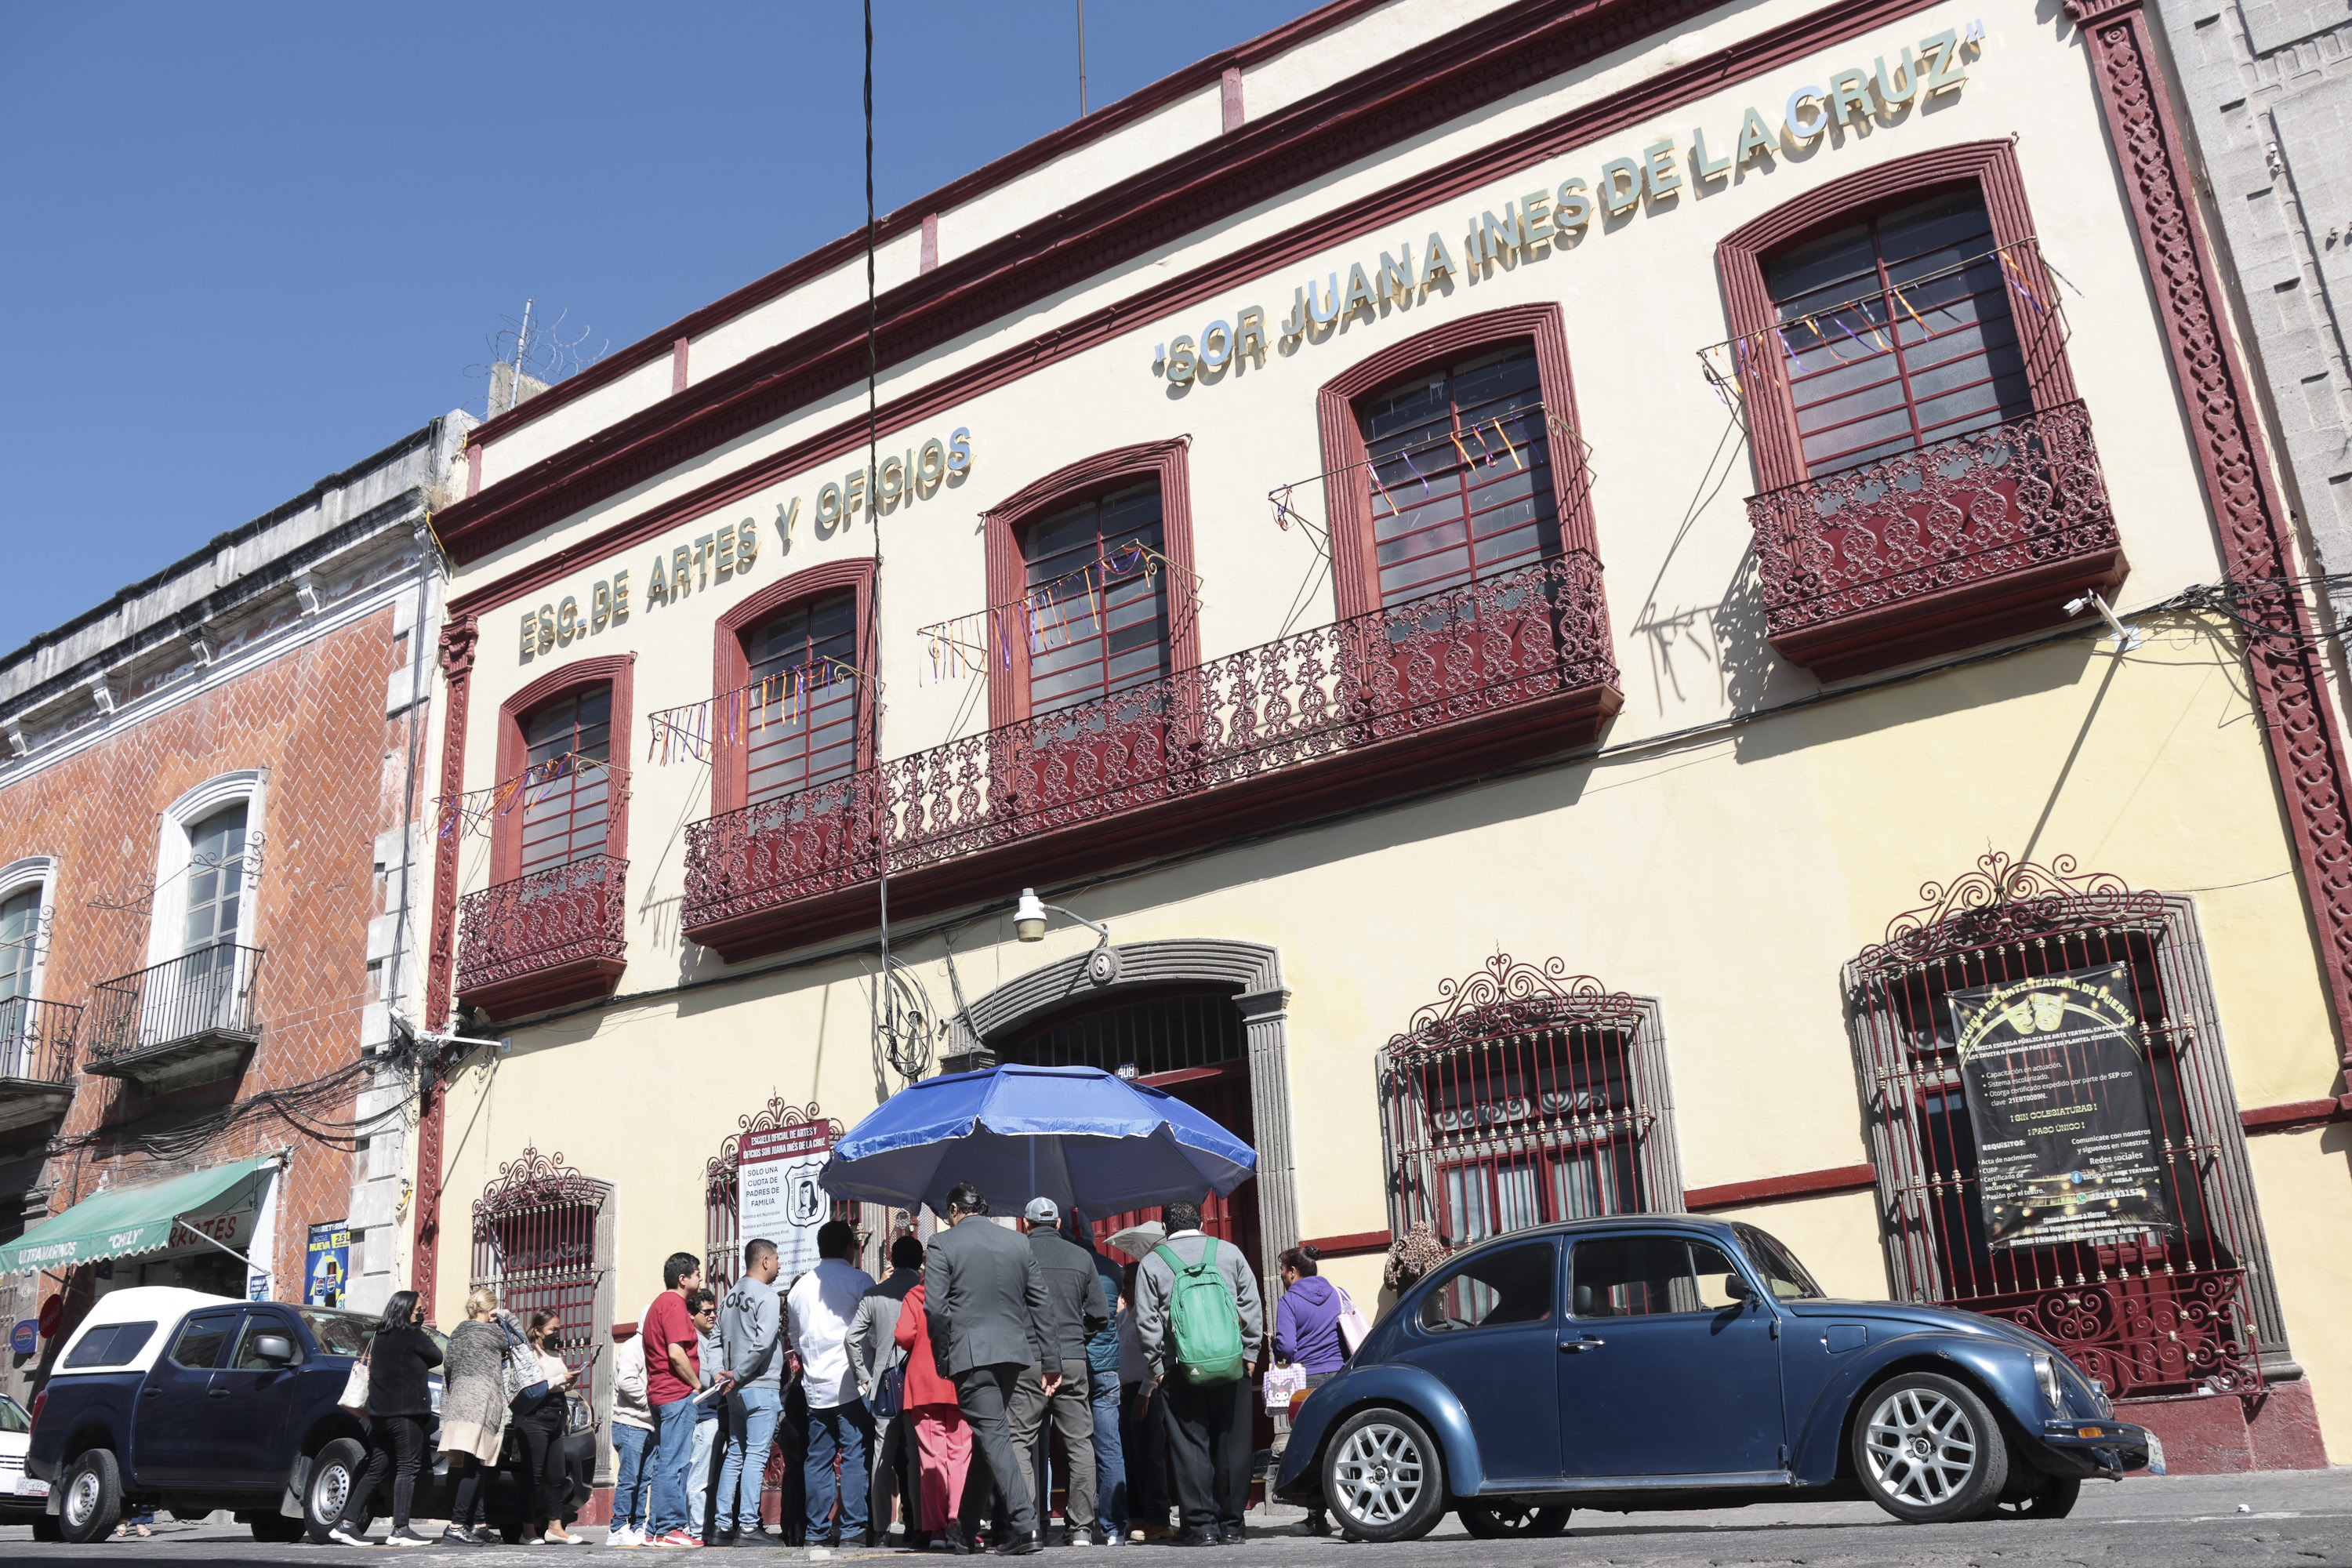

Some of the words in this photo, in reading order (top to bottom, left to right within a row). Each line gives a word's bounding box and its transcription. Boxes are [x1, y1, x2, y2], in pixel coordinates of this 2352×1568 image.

[1282, 232, 1457, 337] JUANA
[1468, 177, 1592, 265] INES
[1601, 139, 1682, 212] DE
[647, 517, 757, 598] ARTES
[776, 495, 800, 539] Y
[816, 426, 971, 522] OFICIOS
[1957, 1007, 1987, 1054] ESCUELA
[1985, 996, 2001, 1010] DE
[2000, 982, 2027, 1000] ARTE
[2030, 978, 2079, 990] TEATRAL
[2081, 982, 2096, 996] DE
[2097, 991, 2136, 1026] PUEBLA
[1993, 1040, 2018, 1048] ESCUELA
[2018, 1036, 2043, 1044] PÚBLICA
[1117, 1062, 1134, 1079] 408
[1986, 1068, 2024, 1079] Capacitación
[2033, 1062, 2062, 1072] actuación.
[2012, 1074, 2049, 1084] escolarizado.
[1990, 1089, 2009, 1098] Otorga
[2011, 1084, 2041, 1094] certificado
[2042, 1080, 2069, 1090] expedido
[2082, 1076, 2099, 1084] parte
[751, 1134, 771, 1145] ESCUELA
[771, 1132, 789, 1142] OFICIAL
[797, 1128, 813, 1138] ARTES
[2071, 1134, 2110, 1145] Comunicate
[743, 1150, 760, 1159] OFICIOS
[761, 1147, 771, 1156] SOR
[771, 1145, 786, 1155] JUANA
[787, 1141, 798, 1152] INÉS
[799, 1142, 805, 1150] DE
[806, 1140, 812, 1149] LA
[813, 1138, 825, 1147] CRUZ
[2082, 1143, 2111, 1153] siguenos
[2004, 1153, 2038, 1162] nacimiento.
[2114, 1152, 2143, 1162] sociales
[1984, 1174, 2015, 1182] Certificado
[746, 1189, 770, 1197] PADRES
[1985, 1182, 2018, 1191] secundaria.
[310, 1241, 330, 1250] NUEVA
[19, 1242, 77, 1265] ULTRAMARINOS
[718, 1291, 754, 1312] OSS
